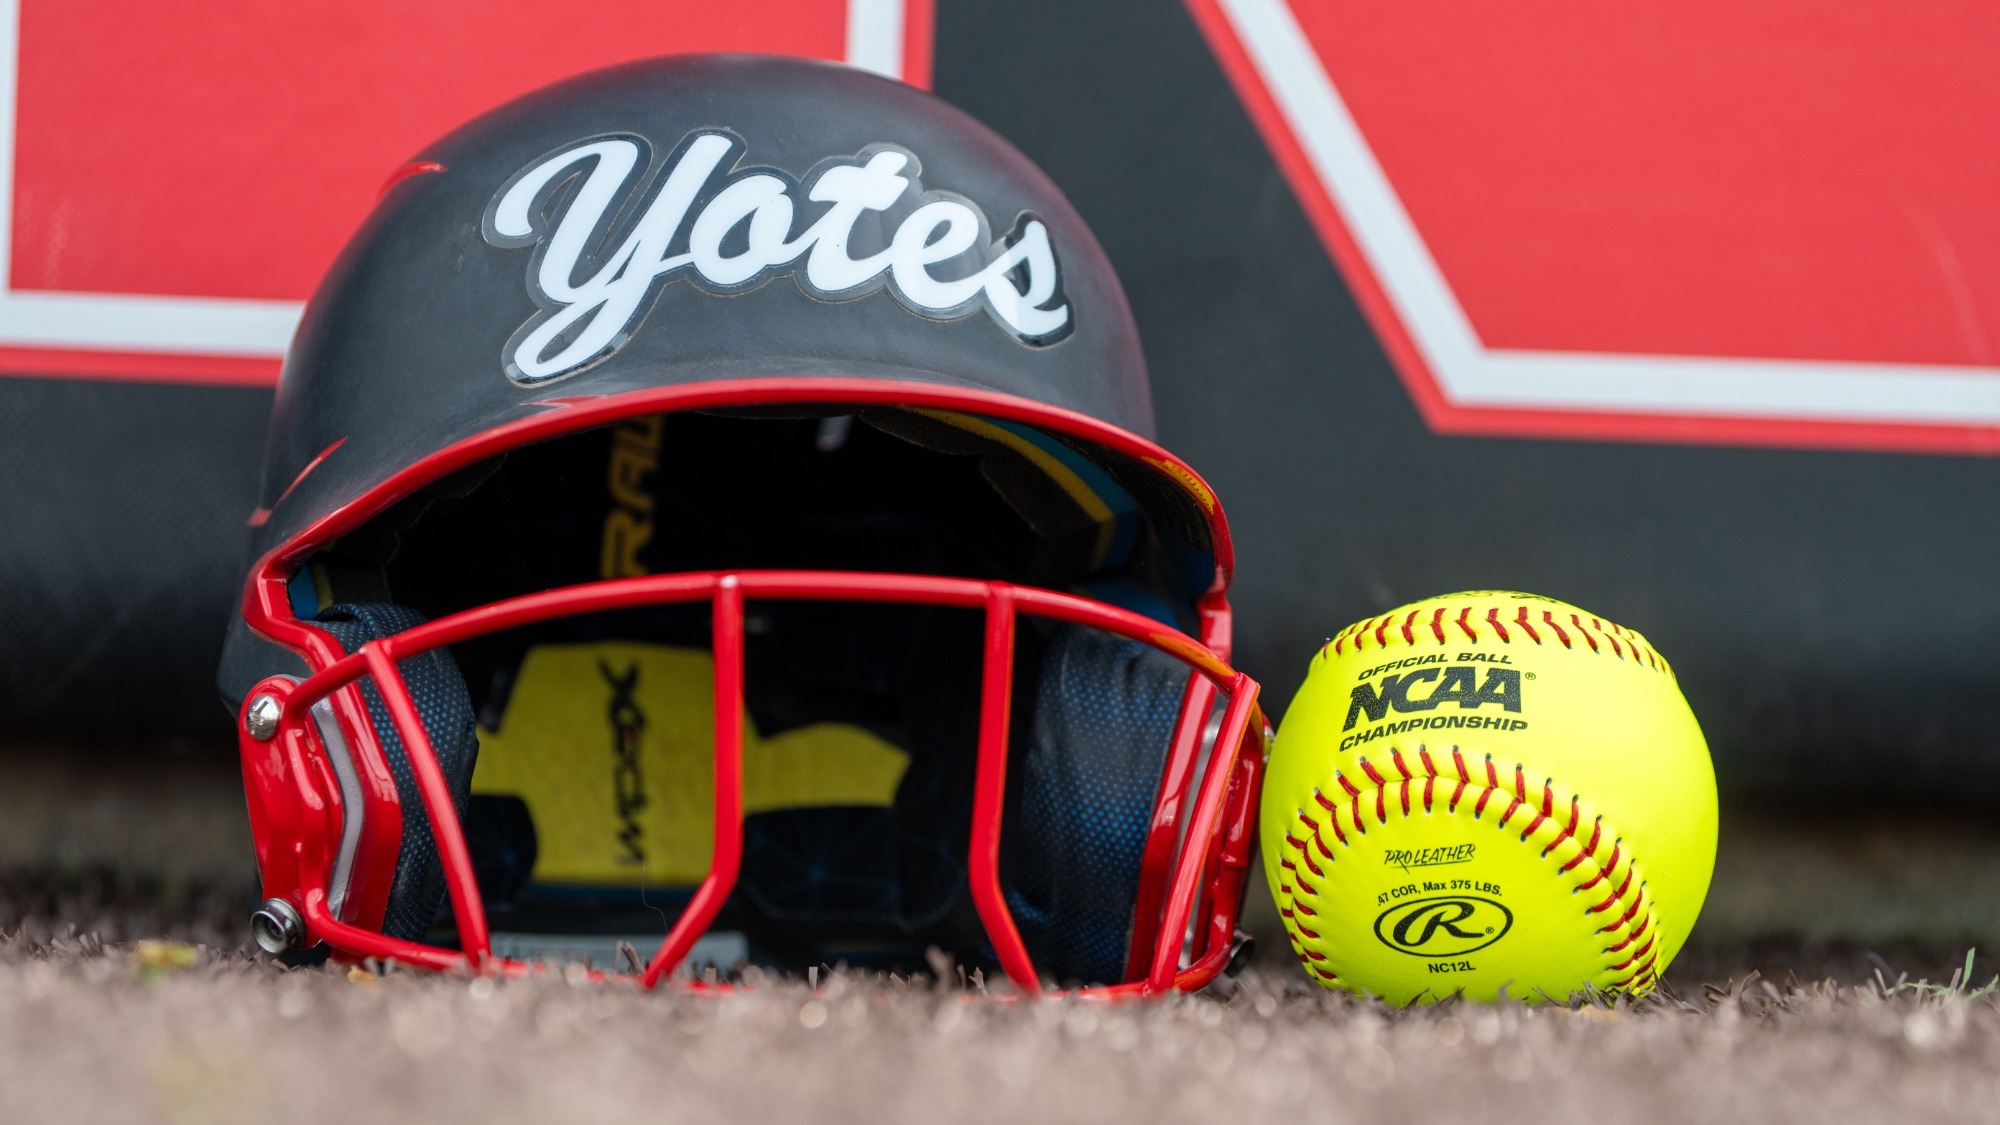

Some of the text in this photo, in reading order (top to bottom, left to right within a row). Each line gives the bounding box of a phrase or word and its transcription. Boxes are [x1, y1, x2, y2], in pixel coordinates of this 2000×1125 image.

[491, 131, 1071, 381] Yotes
[1358, 652, 1512, 681] OFFICIAL BALL
[1342, 666, 1522, 733] NCAA
[1339, 716, 1528, 752] CHAMPIONSHIP
[1378, 880, 1502, 907] .47 COR, Max 375 LBS.
[1428, 960, 1476, 974] NC12L
